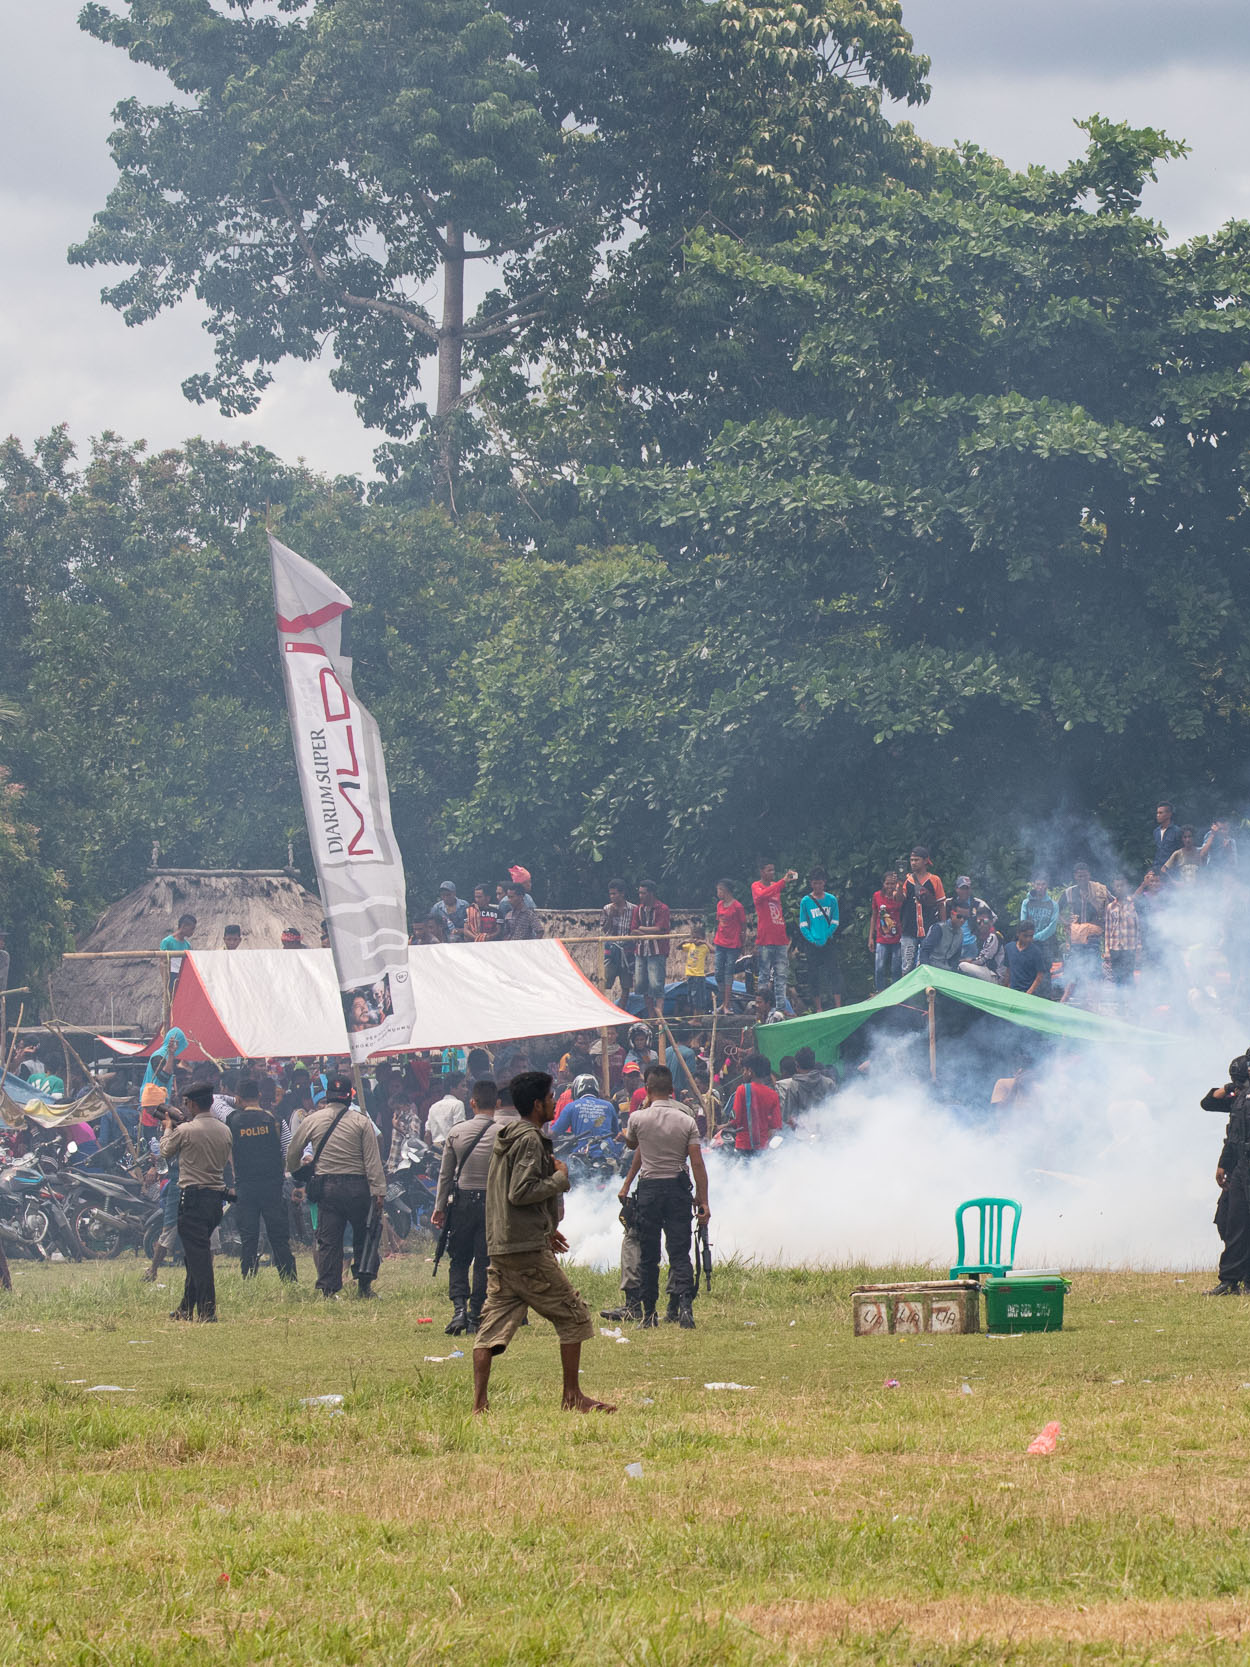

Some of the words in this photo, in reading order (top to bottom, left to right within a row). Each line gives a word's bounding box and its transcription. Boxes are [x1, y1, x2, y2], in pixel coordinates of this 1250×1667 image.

[311, 728, 331, 784] SUPER
[319, 785, 344, 855] DJARUM
[239, 1125, 270, 1137] POLISI
[863, 1309, 884, 1328] LIA
[935, 1311, 956, 1325] LIA
